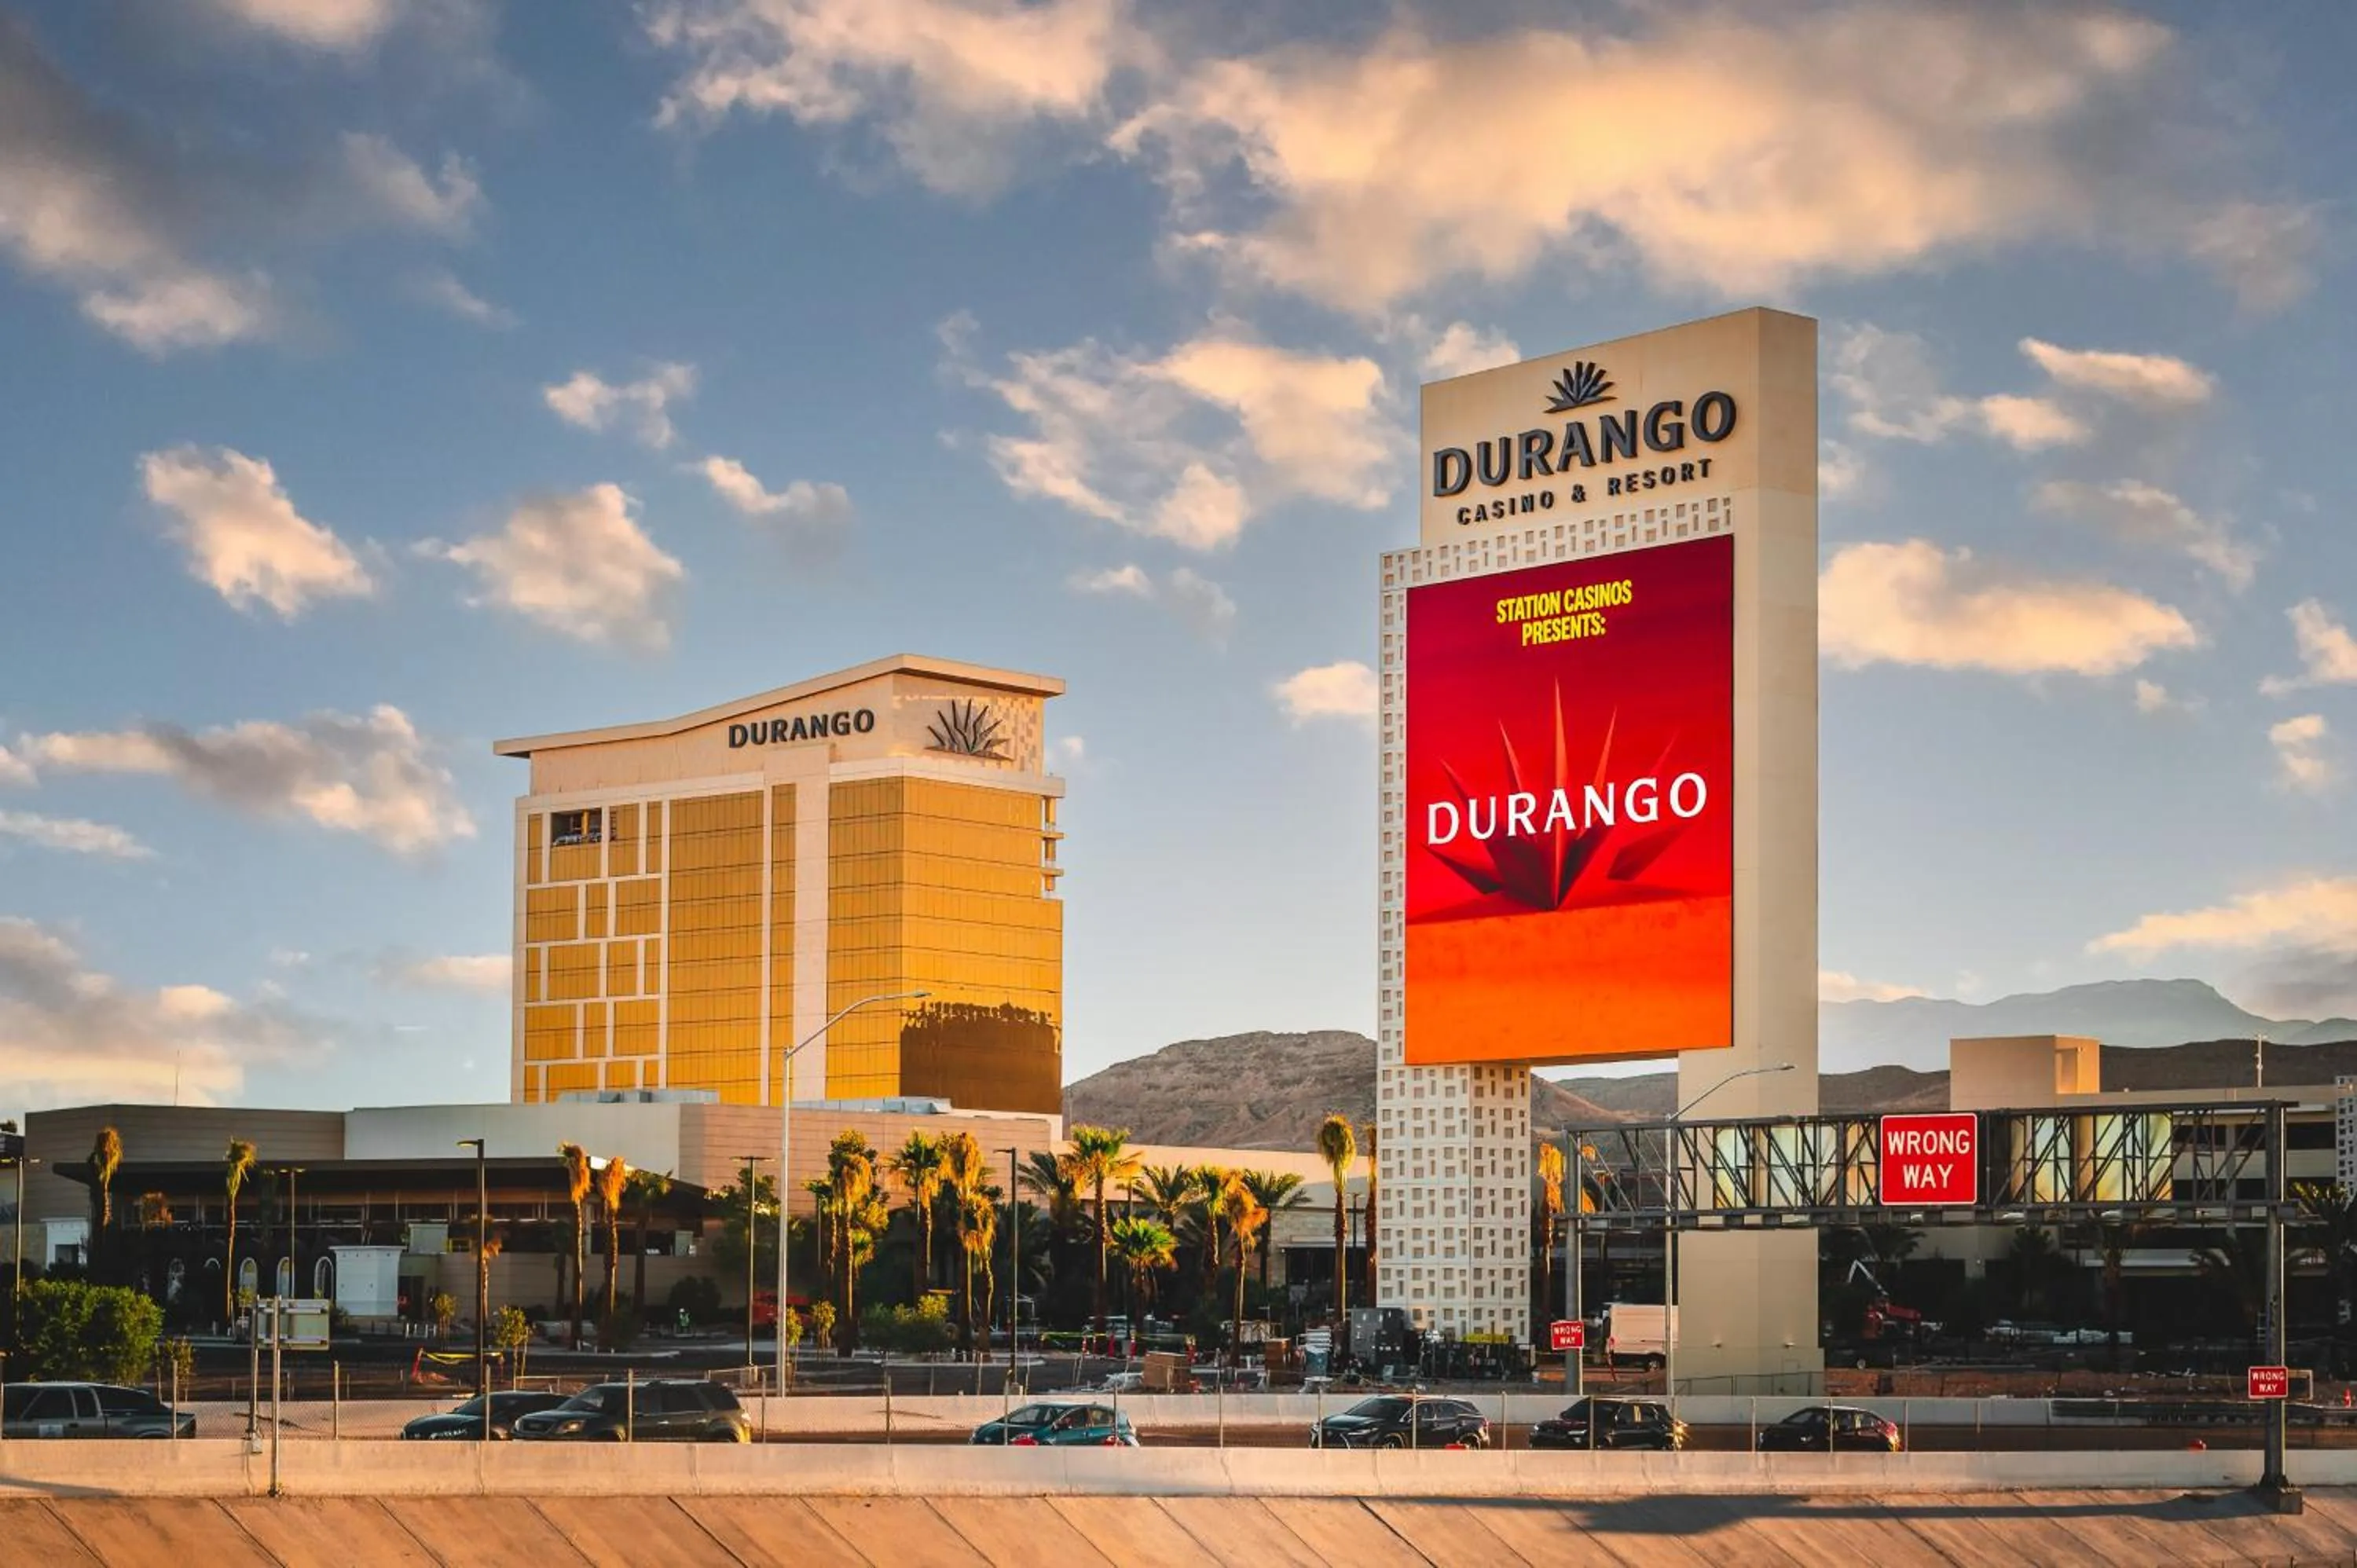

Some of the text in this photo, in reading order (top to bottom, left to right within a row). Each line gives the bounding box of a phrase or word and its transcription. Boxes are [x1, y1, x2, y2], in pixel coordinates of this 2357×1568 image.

[1433, 391, 1737, 497] DURANGO
[1456, 458, 1713, 526] CASINO & RESORT
[1496, 579, 1633, 624] STATION CASINOS
[1521, 611, 1607, 647] PRESENTS:
[728, 708, 875, 749] DURANGO
[1427, 772, 1708, 846] DURANGO
[1887, 1129, 1970, 1156] WRONG
[1902, 1163, 1955, 1189] WAY
[1552, 1324, 1582, 1335] WRONG
[1560, 1335, 1576, 1345] WAY
[2251, 1370, 2286, 1382] WRONG
[2258, 1383, 2278, 1393] WAY
